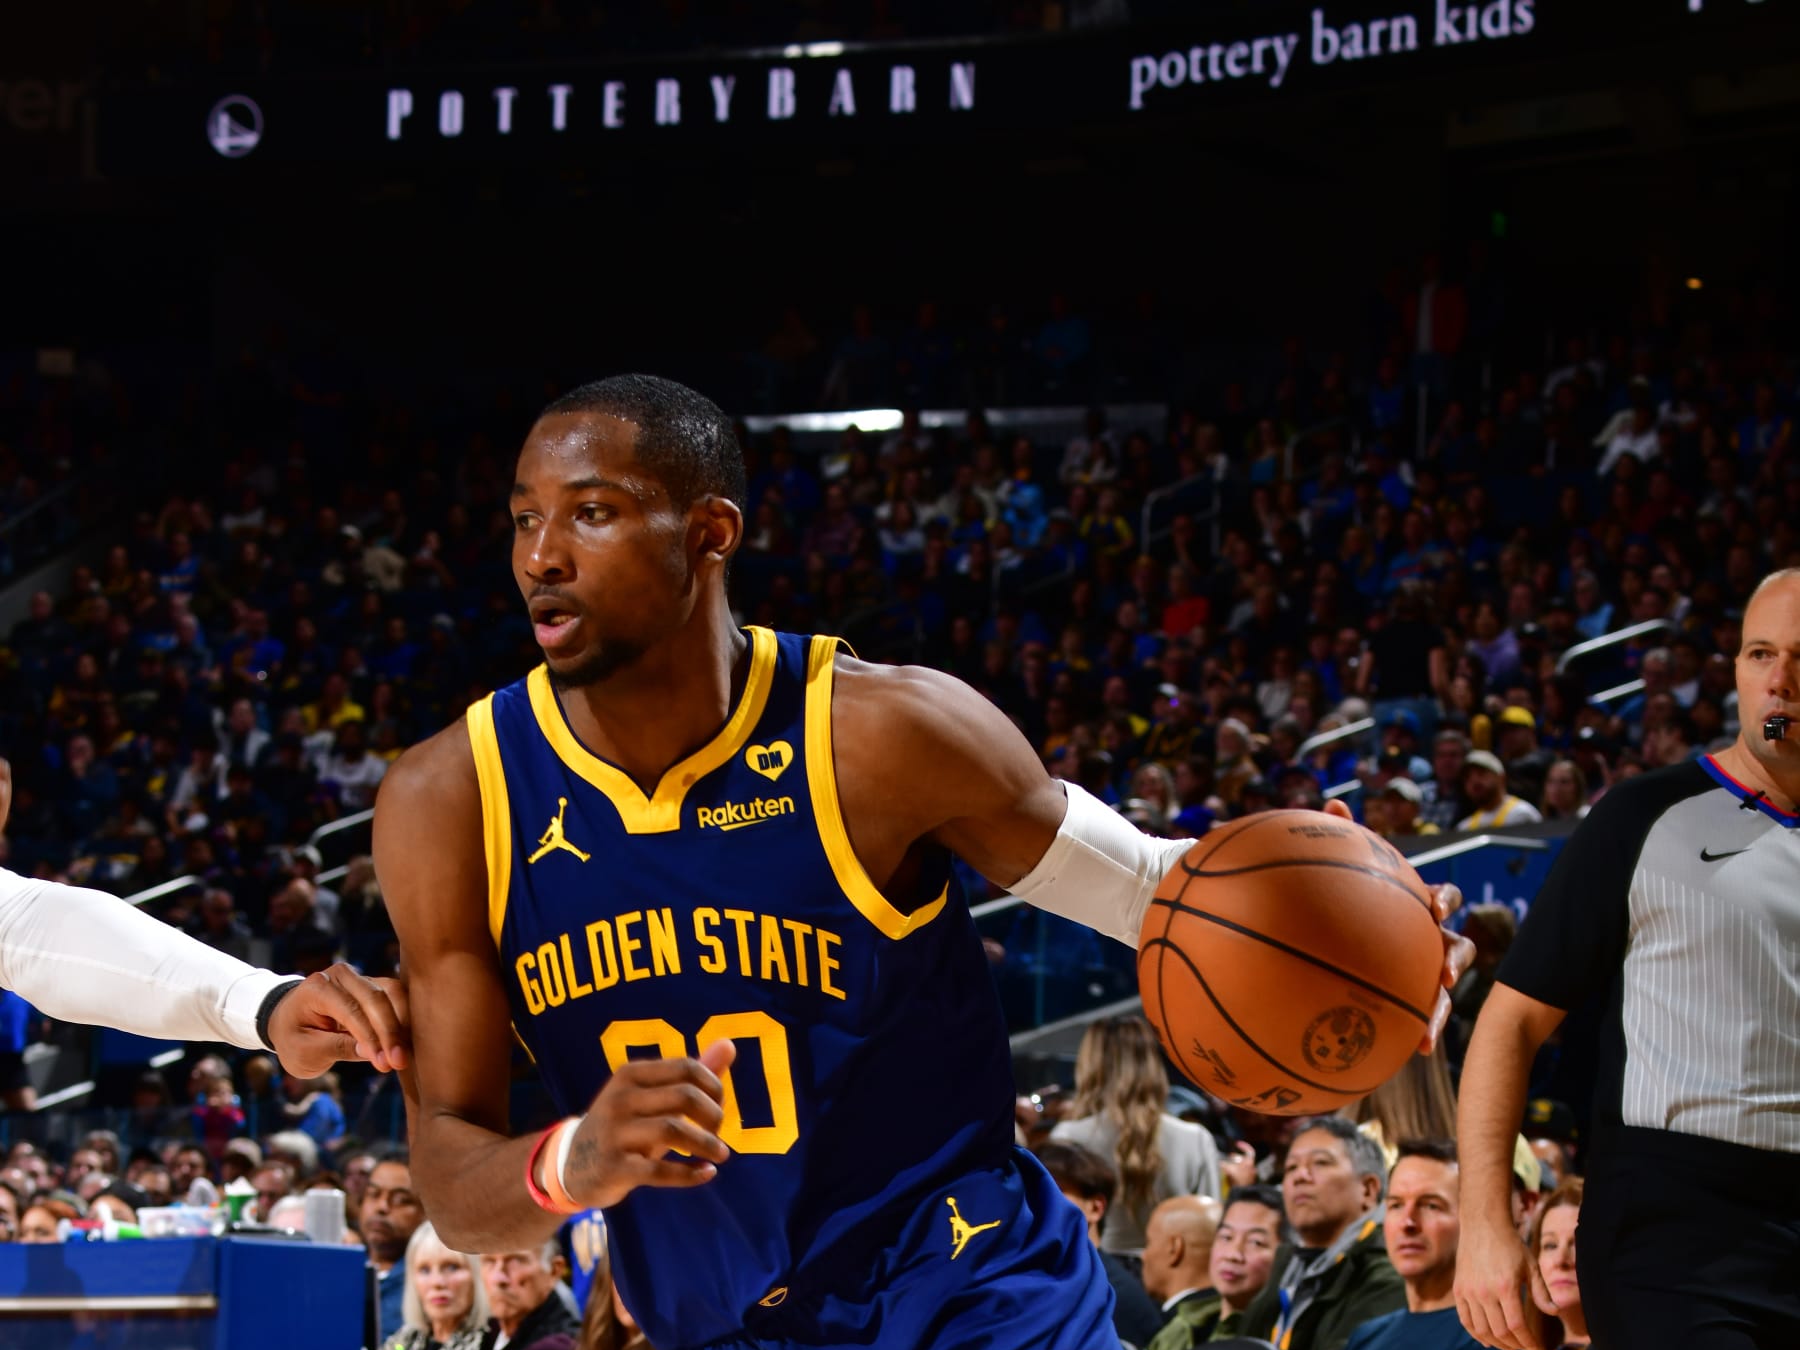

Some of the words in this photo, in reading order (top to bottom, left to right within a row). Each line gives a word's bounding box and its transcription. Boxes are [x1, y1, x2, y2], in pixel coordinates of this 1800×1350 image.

[1129, 34, 1299, 110] pottery
[1311, 9, 1418, 64] barn
[1434, 0, 1535, 46] kids
[757, 750, 784, 771] DM
[697, 796, 795, 829] Rakuten
[515, 907, 682, 1016] GOLDEN
[693, 907, 847, 1001] STATE
